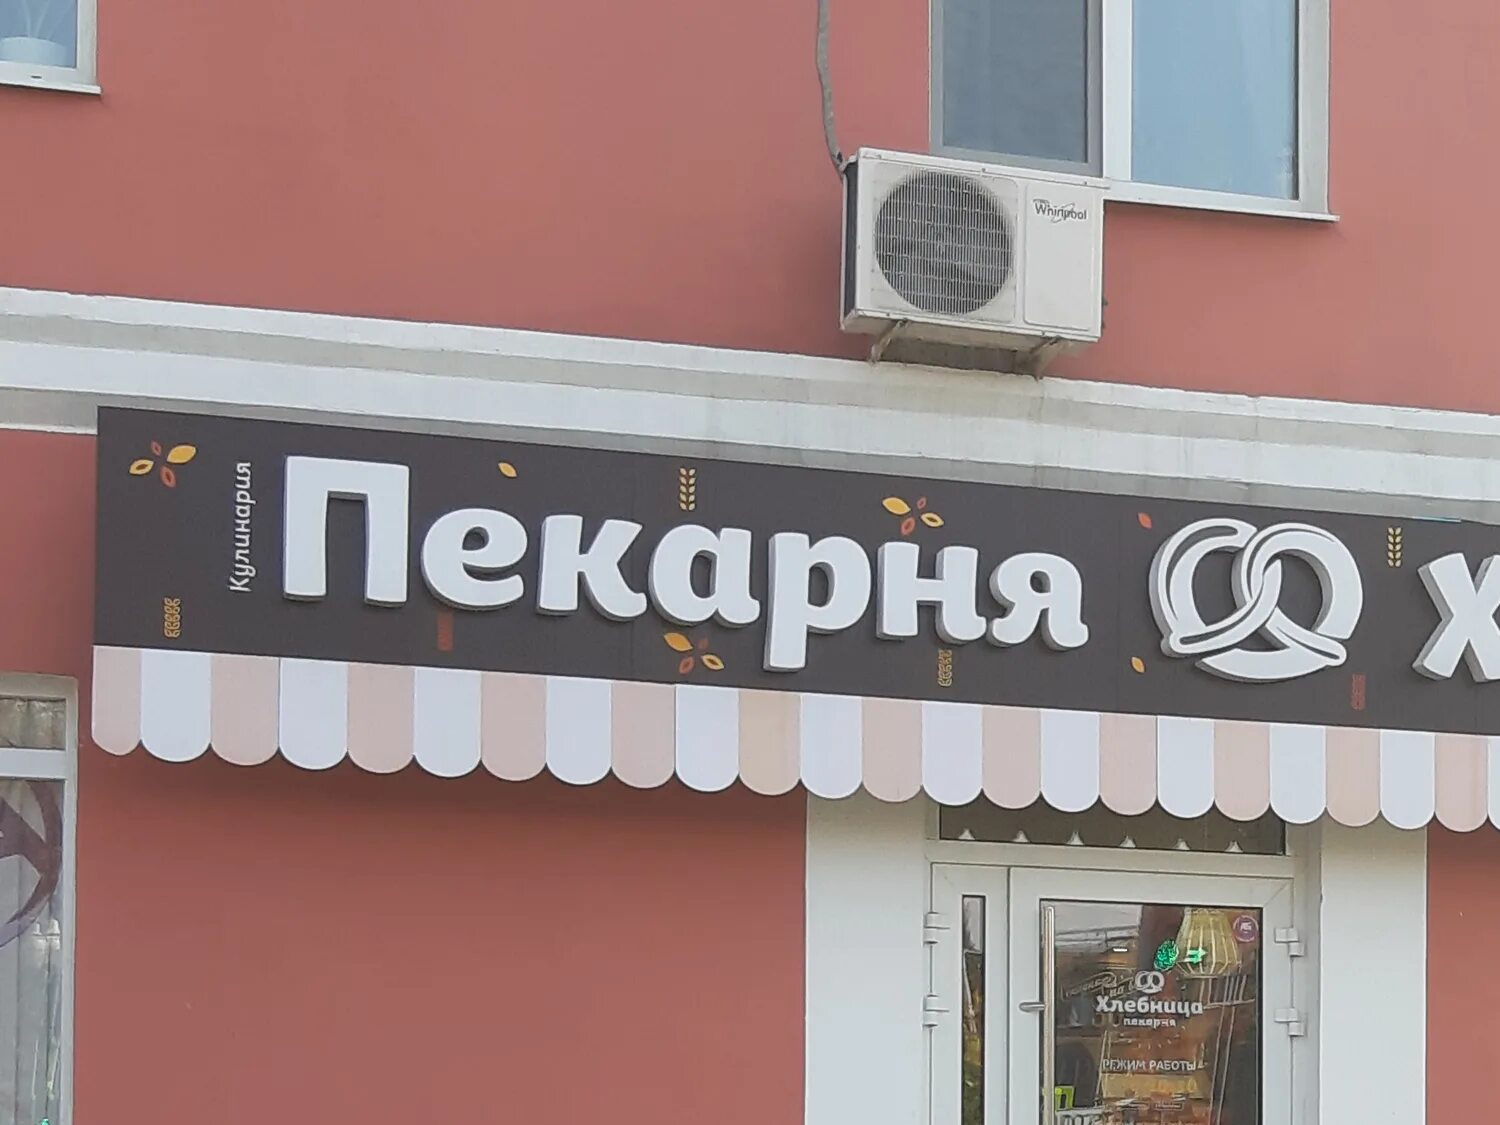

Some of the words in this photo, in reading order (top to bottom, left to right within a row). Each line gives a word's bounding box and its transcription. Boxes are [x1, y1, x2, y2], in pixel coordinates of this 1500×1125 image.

[1033, 201, 1088, 220] Whirlpool
[229, 461, 257, 592] Кулинария
[281, 454, 1090, 672] Пекарня
[1096, 995, 1204, 1018] Хлебница
[1102, 1060, 1146, 1072] РЕЖИМ
[1149, 1060, 1197, 1072] РАБОТЫ
